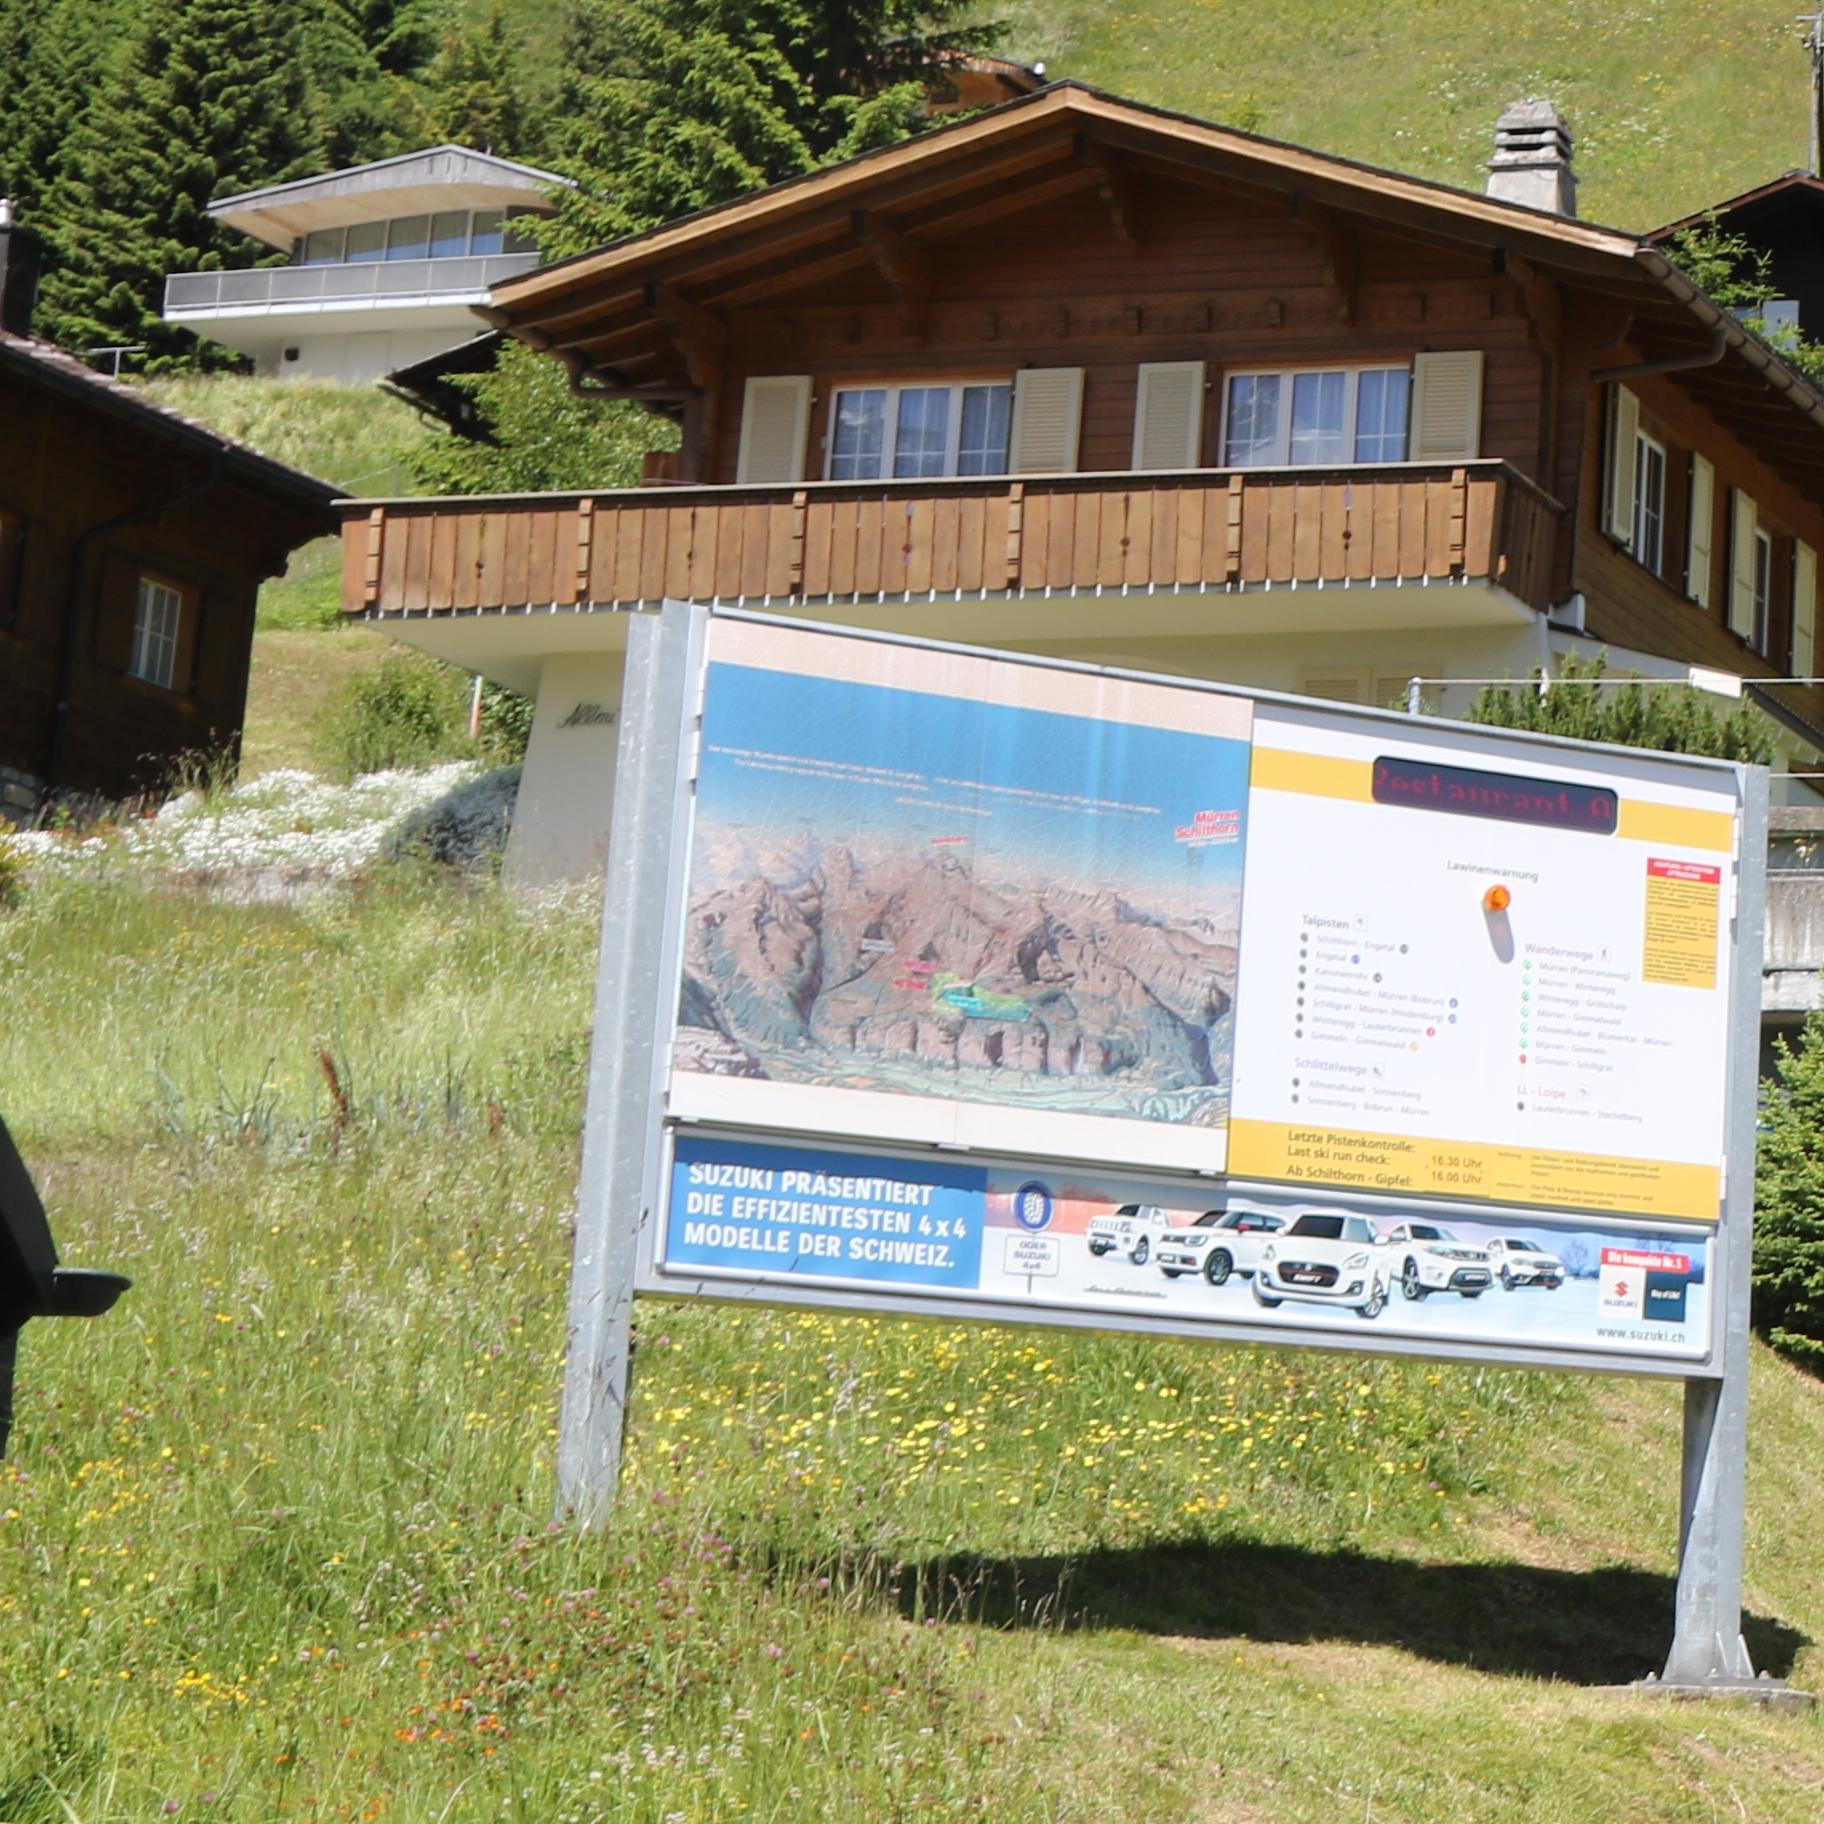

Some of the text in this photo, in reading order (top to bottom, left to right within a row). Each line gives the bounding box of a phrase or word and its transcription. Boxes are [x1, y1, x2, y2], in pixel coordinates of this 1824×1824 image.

[1447, 860, 1539, 883] Lawinenwarnung
[1302, 914, 1350, 930] Talpisten
[1317, 934, 1357, 947] Schilthorn
[1365, 940, 1395, 952] Engetal
[1316, 951, 1347, 962] Engetal
[1525, 943, 1594, 962] Wanderwege
[1539, 962, 1568, 972] Mürren
[1314, 983, 1370, 997] Allmendhubel
[1378, 990, 1408, 1001] Mürren
[1538, 978, 1567, 988] Mürren
[1575, 982, 1615, 996] Winteregg
[1538, 994, 1579, 1007] Winteregg
[1359, 1004, 1389, 1016] Mürren
[1537, 1009, 1566, 1020] Mürren
[1312, 1015, 1355, 1030] Winteregg
[1536, 1025, 1590, 1038] Allmendhubel
[1644, 1037, 1672, 1047] Mürren
[1536, 1040, 1564, 1051] Mürren
[1295, 1057, 1368, 1076] Schlittelwege
[1309, 1080, 1365, 1093] Allmendhubel
[1538, 1086, 1566, 1099] Loipe
[1401, 1105, 1430, 1116] Mürren
[1288, 1130, 1415, 1153] Letzte Pistenkontrolle:
[1287, 1145, 1390, 1165] Last ski run check:
[1432, 1155, 1482, 1169] 16.30 Uhr
[1287, 1165, 1303, 1176] Ab
[1307, 1167, 1364, 1183] Schilthorn
[1375, 1173, 1413, 1187] Gipfel:
[1431, 1171, 1482, 1184] 16.00 Uhr
[689, 1163, 934, 1207] SUZUKI PRÄSENTIERT
[687, 1192, 724, 1217] DIE
[732, 1198, 910, 1234] EFFIZIENTESTEN
[684, 1223, 955, 1268] MODELLE DER SCHWEIZ.
[1018, 1240, 1048, 1250] ODER
[1013, 1250, 1051, 1261] SUZUKI
[1607, 1251, 1622, 1263] Die
[1663, 1257, 1675, 1267] Nr.
[1604, 1299, 1638, 1308] SUZUKI
[1596, 1327, 1685, 1344] www.suzuki.ch
